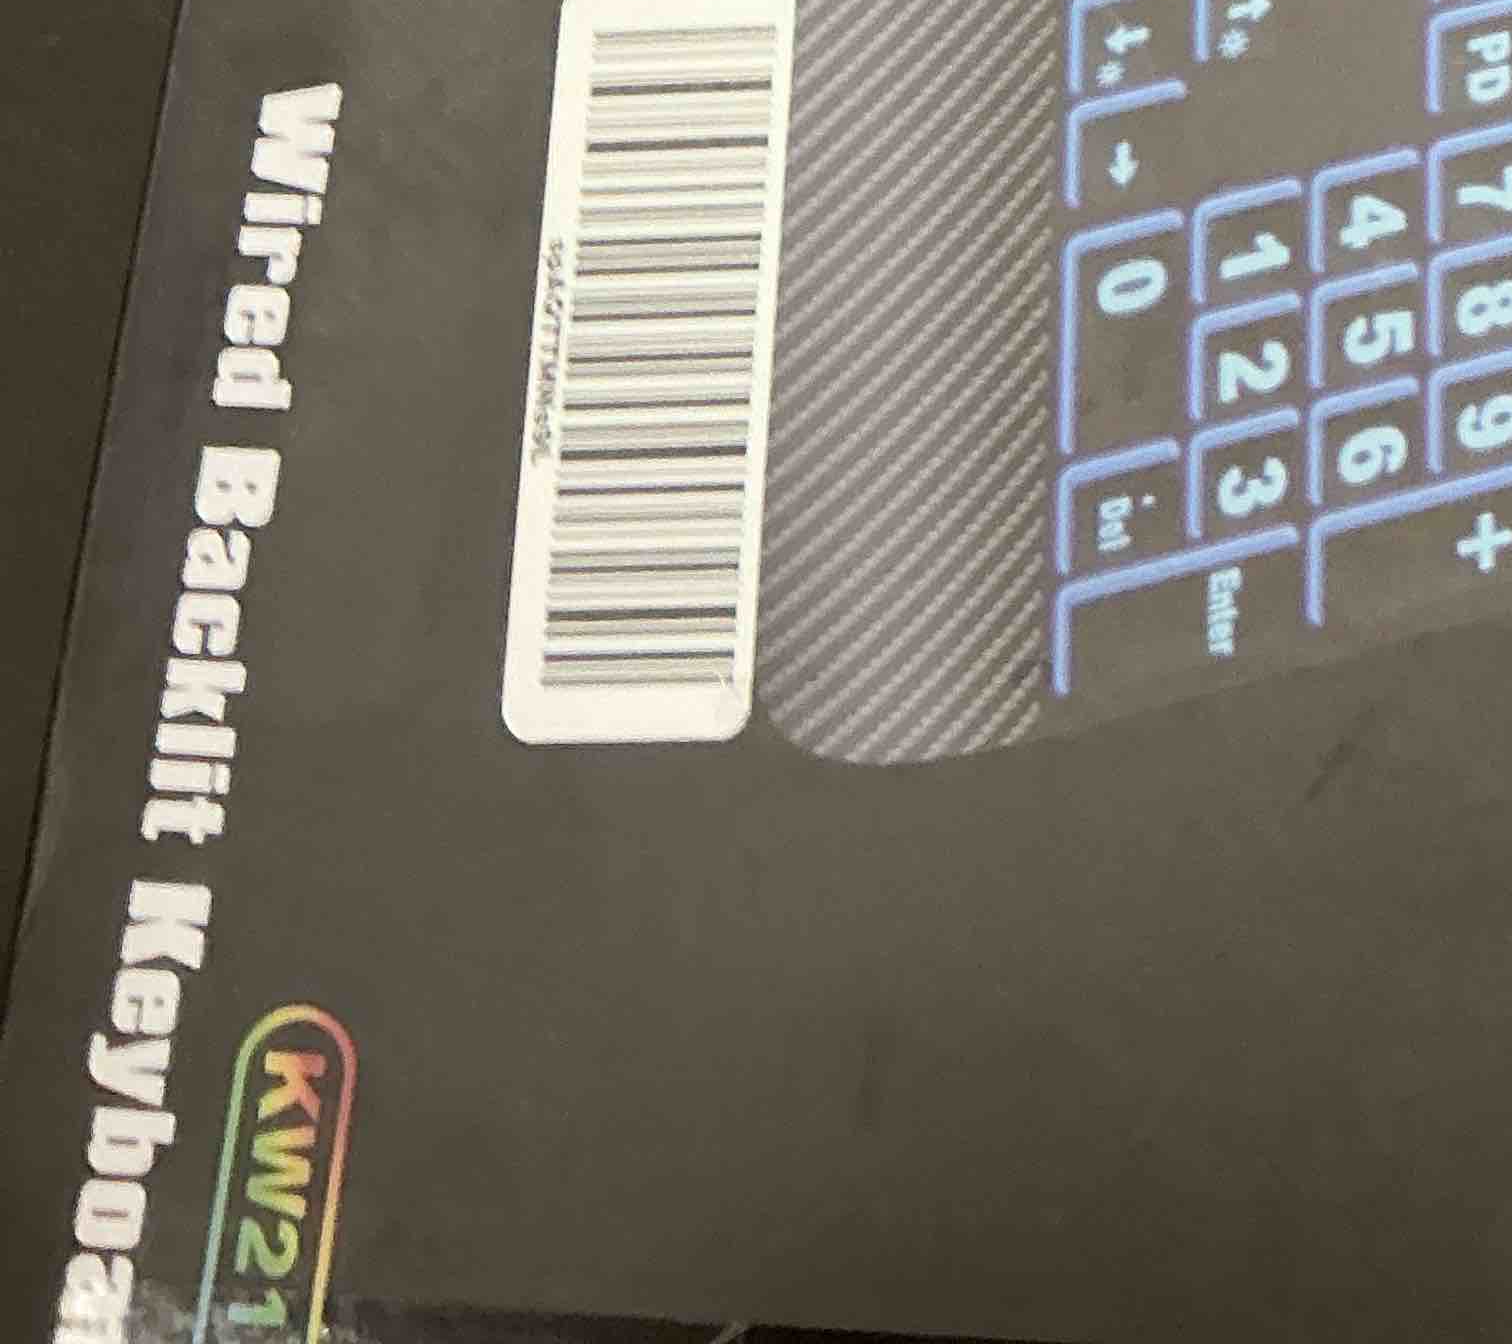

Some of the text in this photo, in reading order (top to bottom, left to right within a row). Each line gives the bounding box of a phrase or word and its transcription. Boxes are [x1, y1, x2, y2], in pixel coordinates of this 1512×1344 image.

[1466, 30, 1512, 103] PD
[211, 82, 342, 410] Wired
[1338, 194, 1408, 249] 4
[1219, 231, 1290, 280] 1
[1096, 259, 1168, 315] 0
[1344, 310, 1415, 365] 5
[1218, 340, 1289, 403] 2
[1336, 426, 1407, 484] 6
[1216, 457, 1288, 517] 3
[1206, 566, 1241, 654] Enter
[139, 445, 281, 845] Backlit
[226, 1050, 328, 1330] KW21
